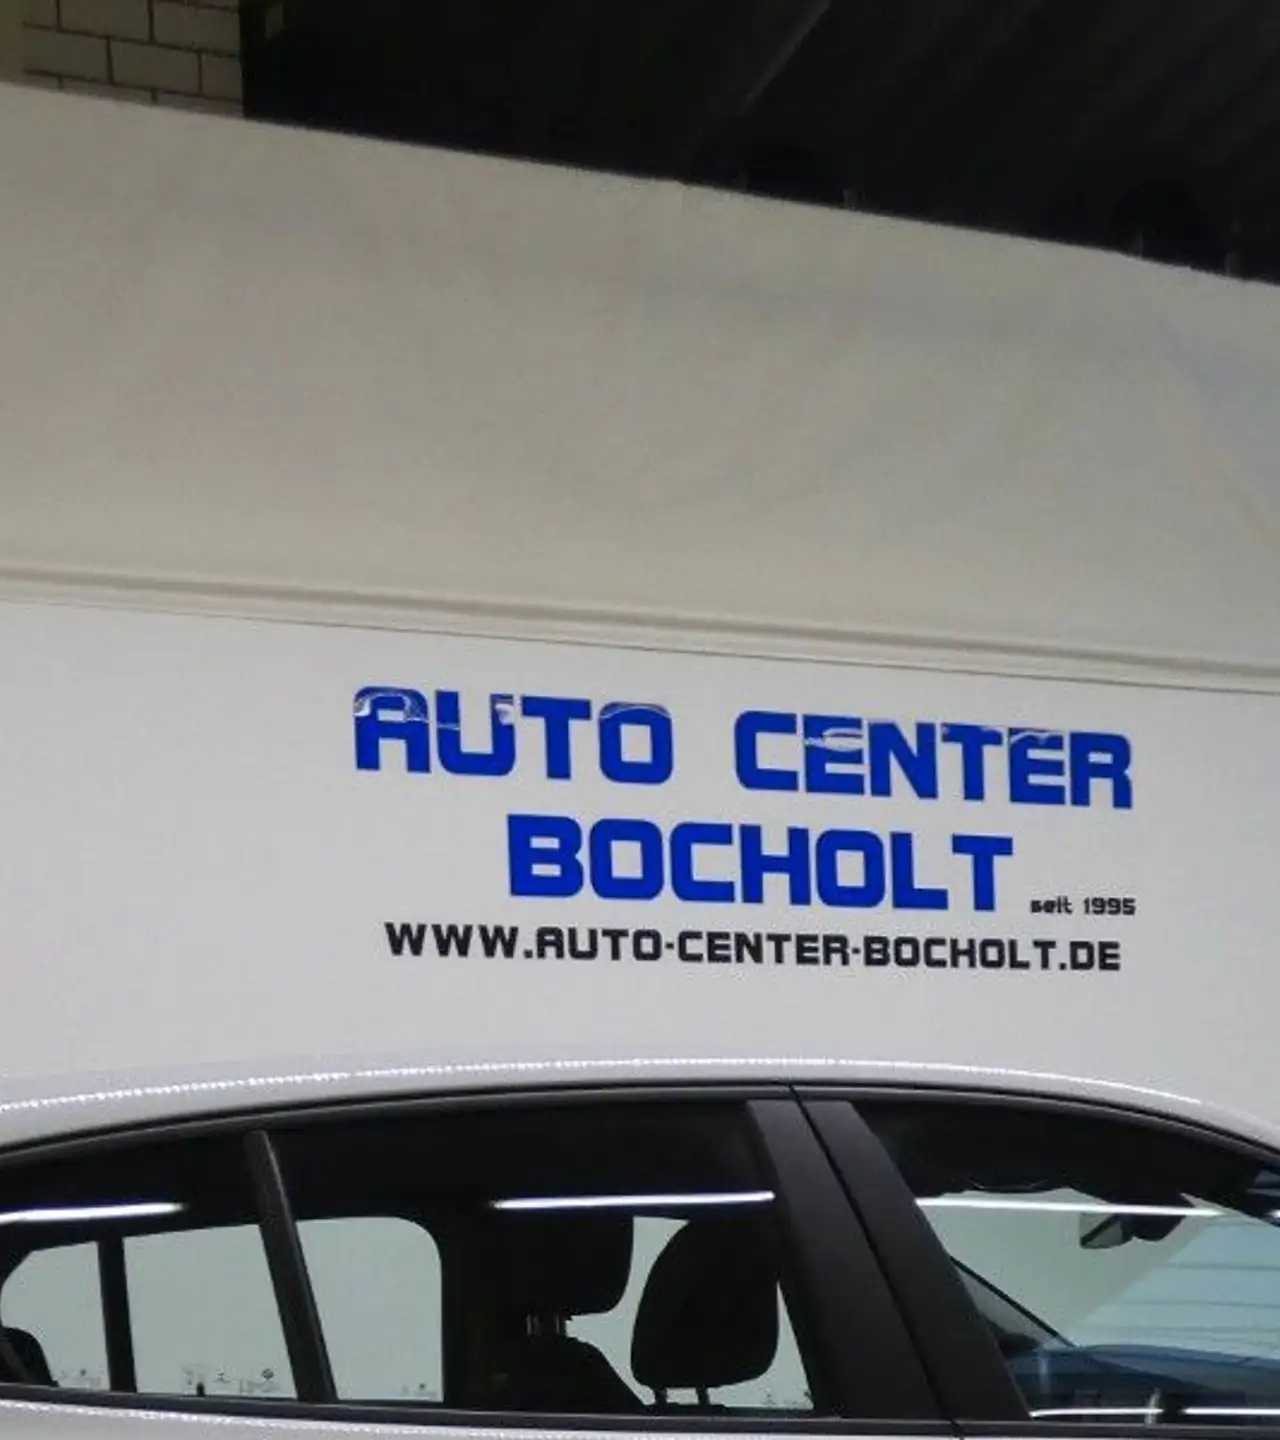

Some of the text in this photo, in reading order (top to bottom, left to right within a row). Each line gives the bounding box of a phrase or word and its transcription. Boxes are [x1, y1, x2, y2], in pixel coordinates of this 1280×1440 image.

[352, 685, 1134, 810] AUTO CENTER
[506, 812, 1016, 913] BOCHOLT
[1083, 896, 1137, 916] 1995
[384, 922, 1122, 972] WWW.AUTO-CENTER-BOCHOLT.DE
